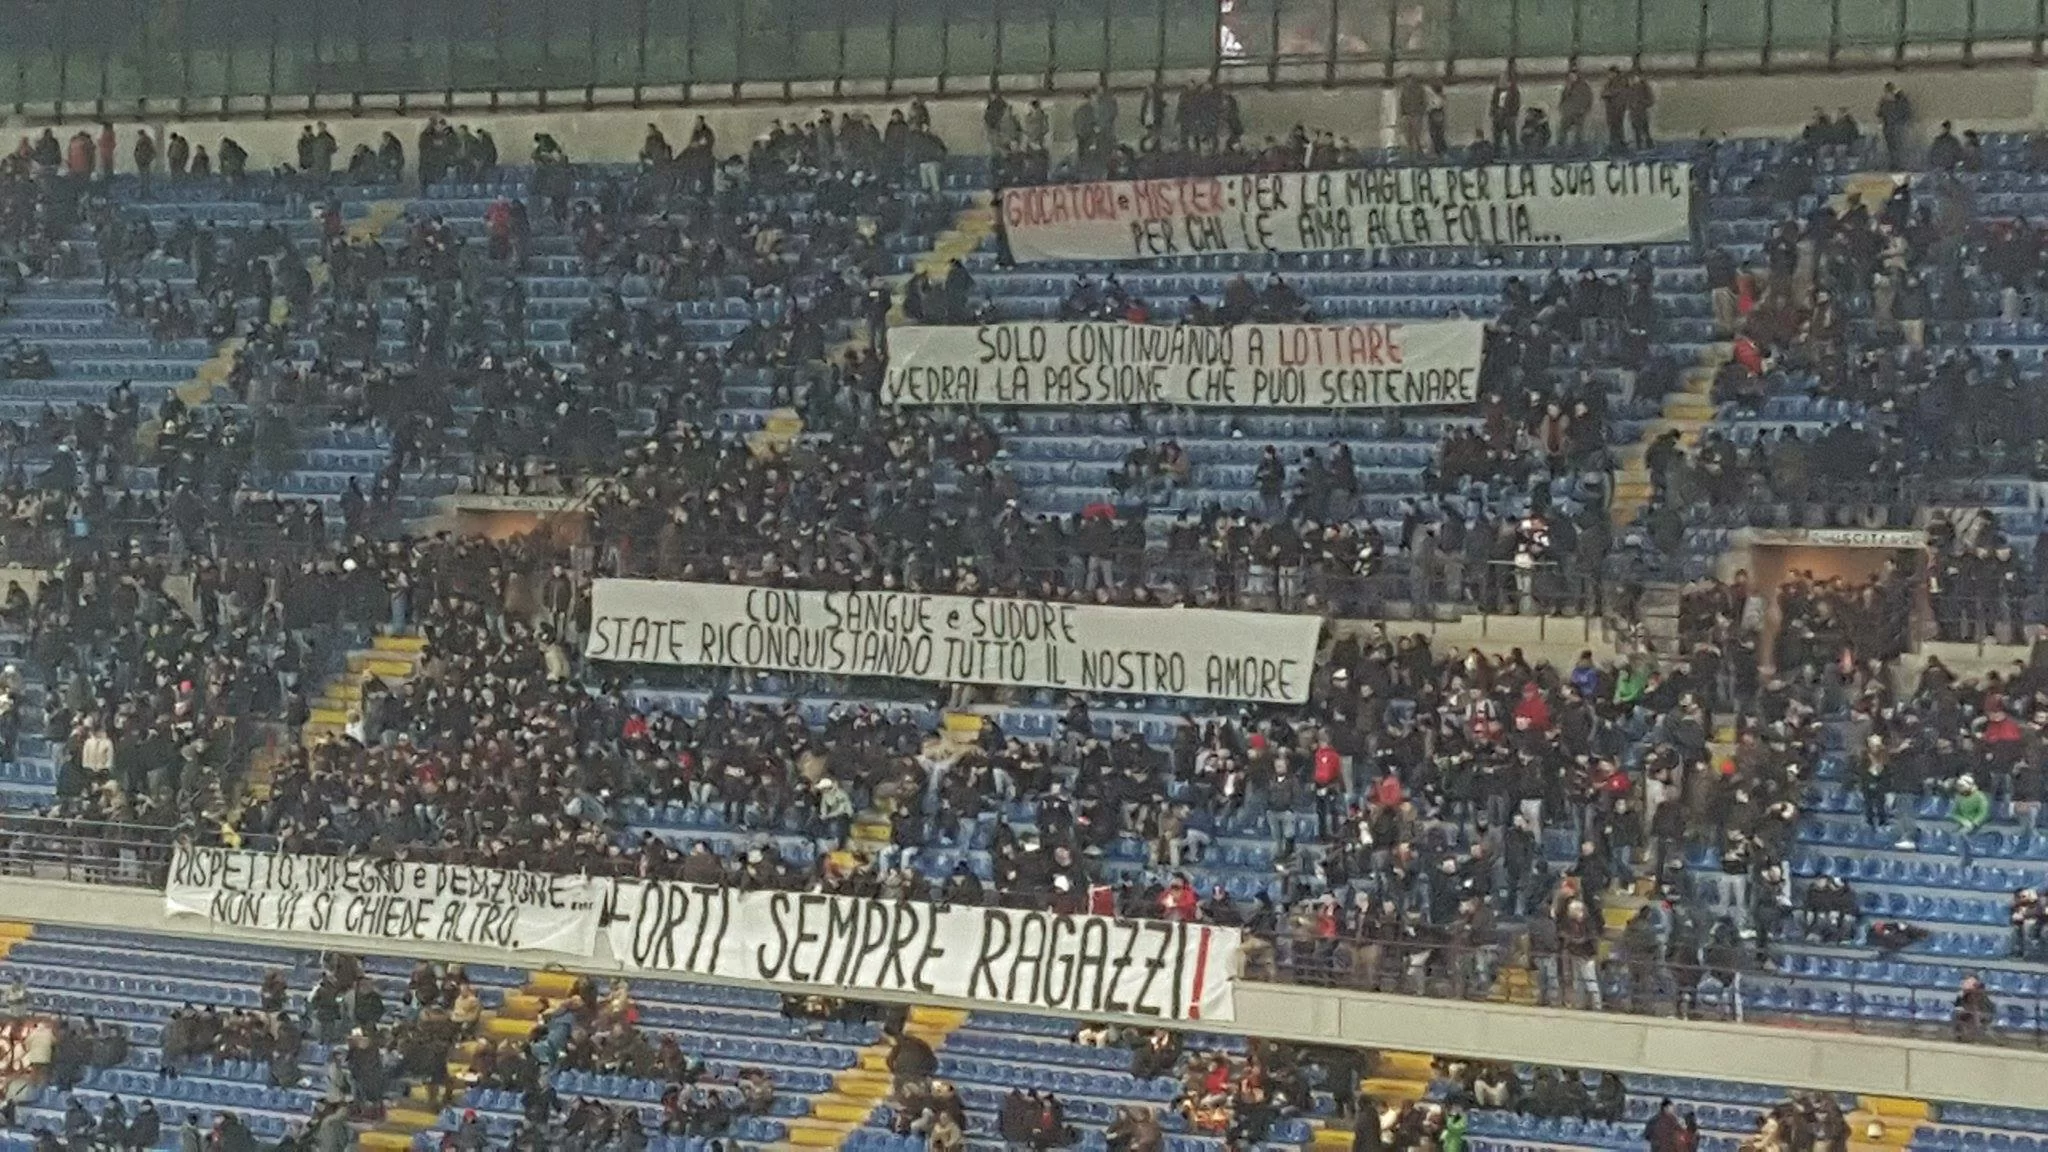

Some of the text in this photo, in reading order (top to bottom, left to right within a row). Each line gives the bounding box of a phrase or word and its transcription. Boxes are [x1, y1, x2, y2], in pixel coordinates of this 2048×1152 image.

[1006, 184, 1116, 227] GIOCATORI
[1118, 195, 1129, 210] e
[1241, 174, 1287, 212] PER
[1301, 174, 1331, 209] LA
[1446, 167, 1489, 200] PER
[1504, 163, 1537, 199] LA
[1551, 162, 1596, 197] SUA
[1131, 203, 1561, 254] PER CHI LE AMA ALLA FOLLIA...
[978, 323, 1404, 366] SOLO CONTINUANDO A LOTTARE
[889, 364, 1475, 405] VEDRAI LA PASSIONE CHE PUOI SCATENARE
[746, 589, 1077, 643] CON SANGUE e SUDORE
[592, 616, 1298, 700] STATE RICONQUISTANDO TUTTO IL NOSTRO AMORE
[306, 856, 404, 893] IMPEGNO
[414, 868, 427, 888] e
[211, 889, 520, 948] NON VI SI CHIEDE ALTRO.
[611, 877, 1211, 1020] FORTI SEMPRE RAGAZZI!
